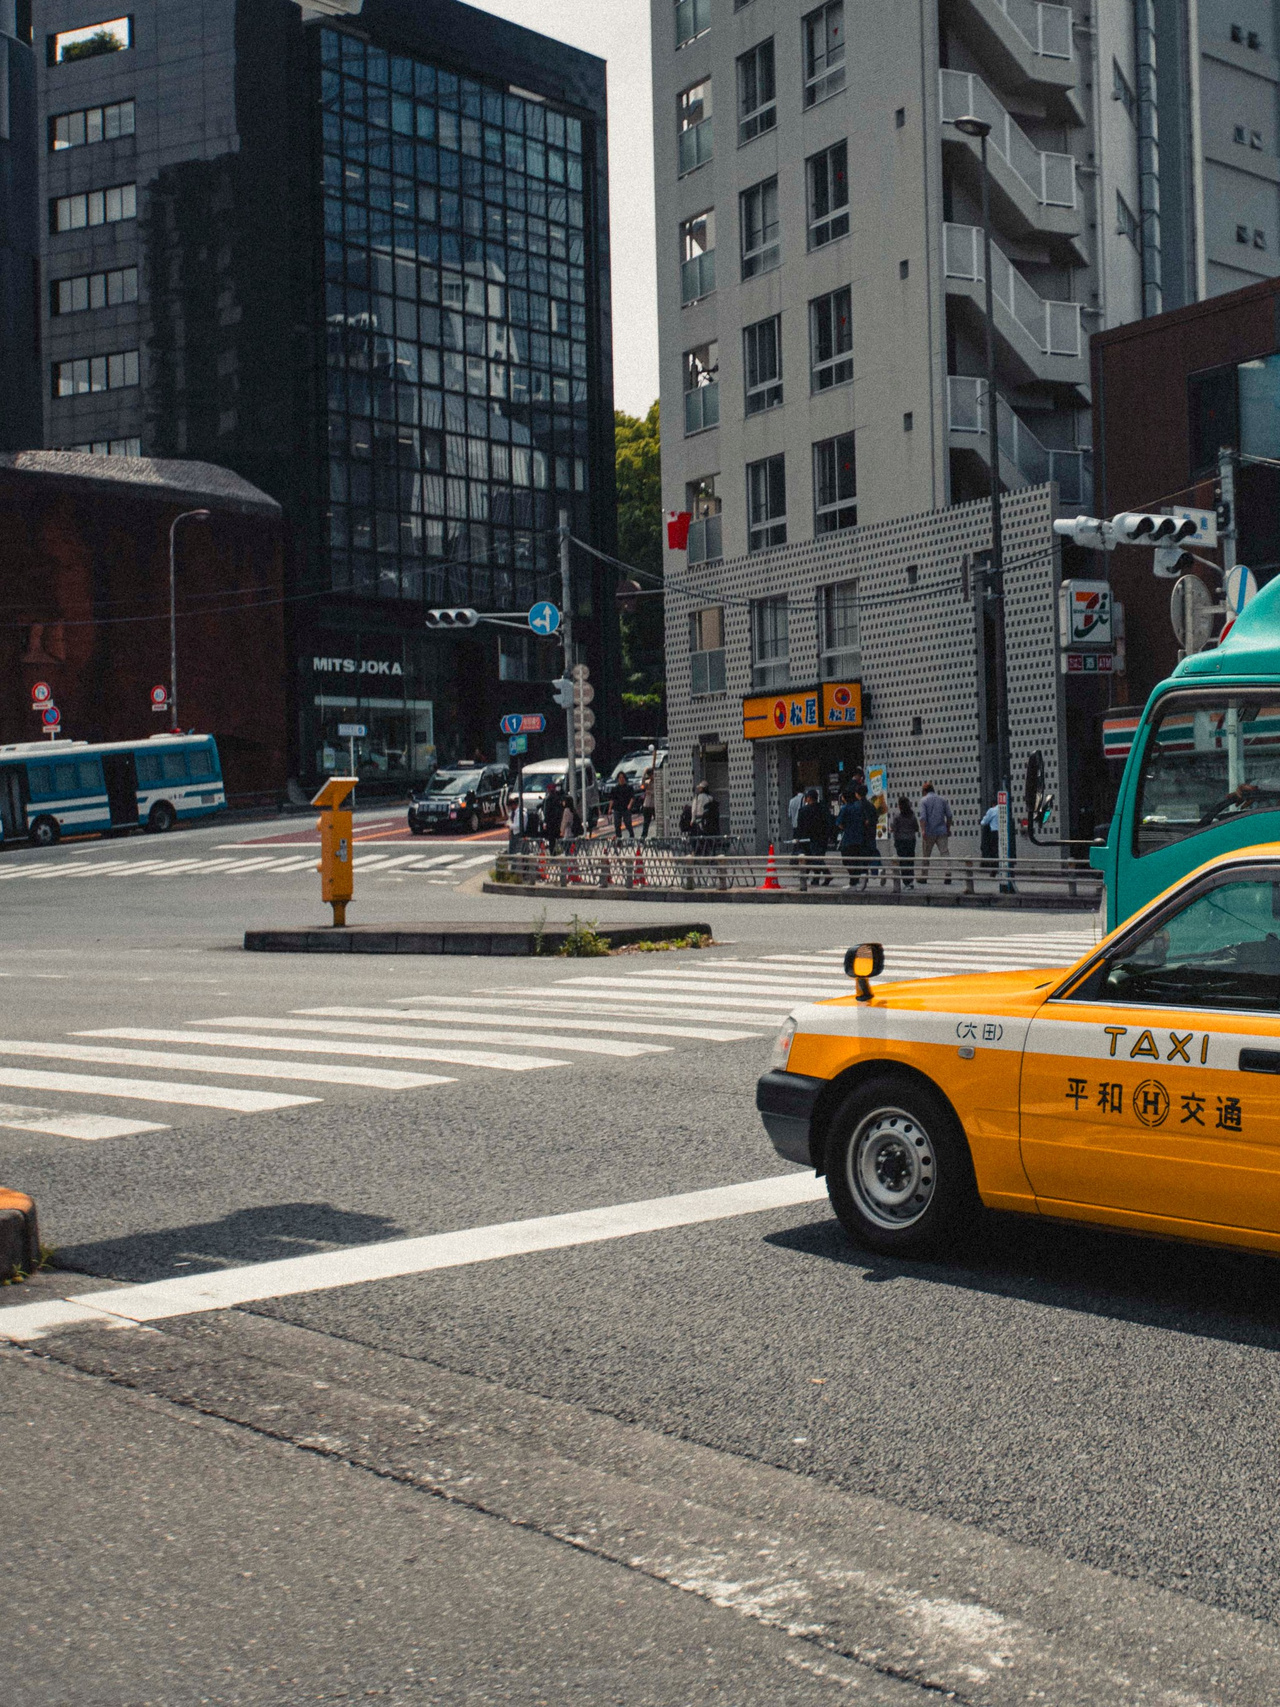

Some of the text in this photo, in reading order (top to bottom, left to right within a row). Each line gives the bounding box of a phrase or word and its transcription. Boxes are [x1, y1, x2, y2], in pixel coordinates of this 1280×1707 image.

[512, 717, 517, 730] 1
[790, 697, 817, 727] 松屋
[828, 706, 856, 722] 松屋
[1103, 1026, 1210, 1065] TAXI
[1065, 1077, 1123, 1115] 平和
[1180, 1092, 1243, 1133] 交通
